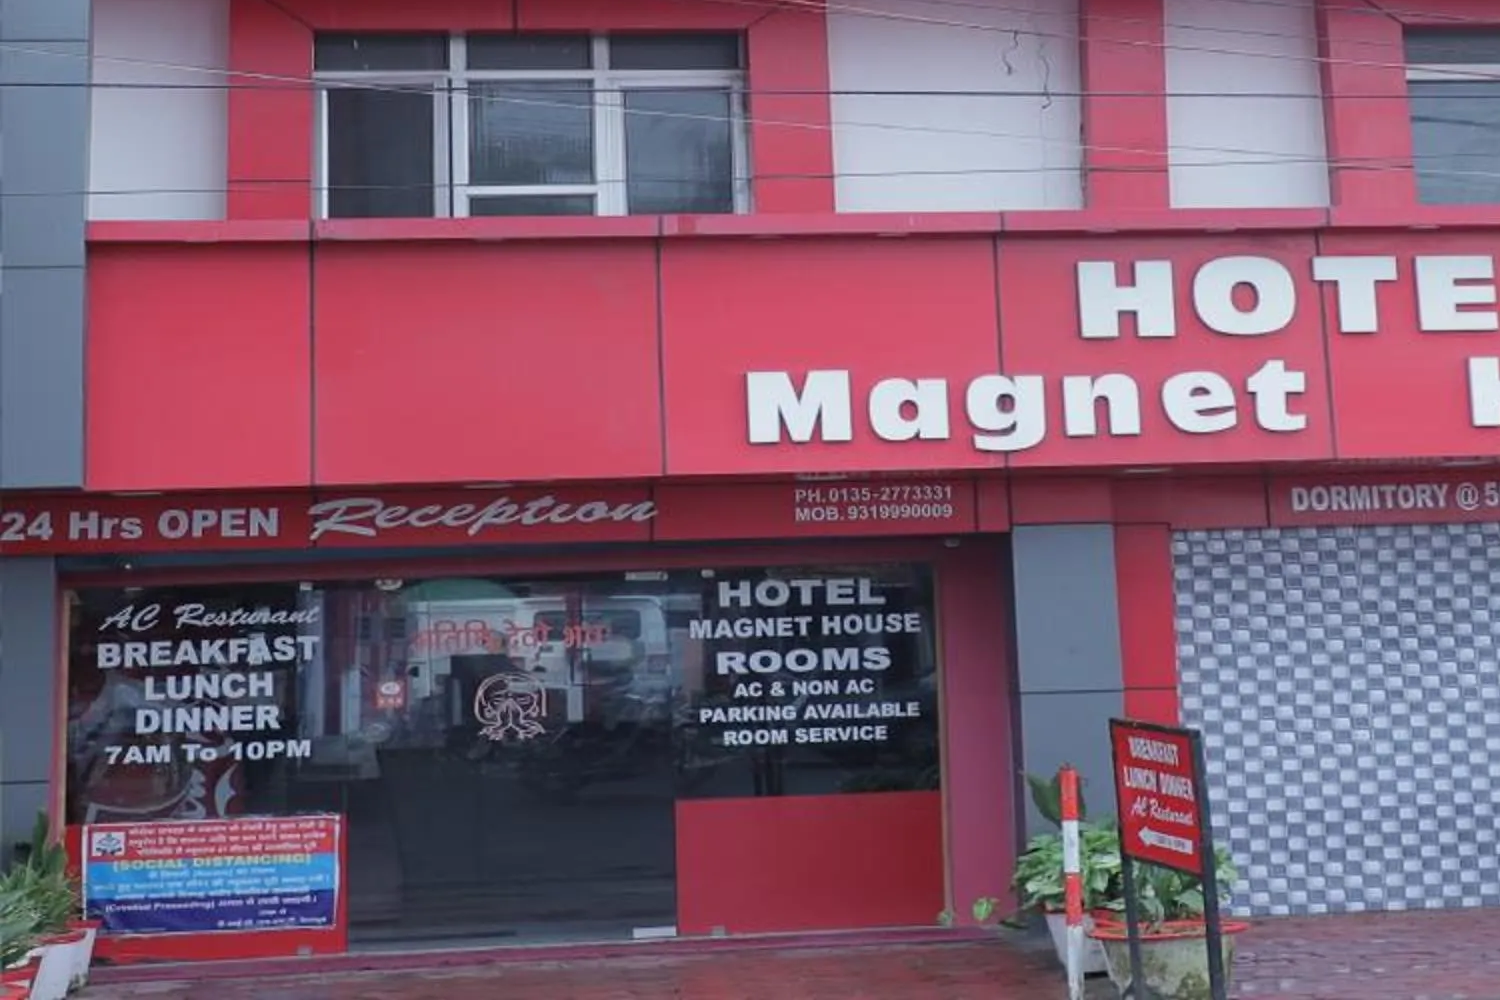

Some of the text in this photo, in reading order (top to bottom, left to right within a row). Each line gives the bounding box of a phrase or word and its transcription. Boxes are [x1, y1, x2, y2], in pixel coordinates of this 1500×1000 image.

[745, 358, 1307, 453] Magnet
[1291, 482, 1448, 513] DORMITORY
[0, 507, 279, 541] 24 Hrs OPEN
[308, 496, 659, 542] Reception
[718, 578, 887, 608] HOTEL
[99, 603, 162, 631] AC
[690, 613, 922, 640] MAGNET HOUSE
[97, 634, 320, 669] BREAKFAST
[716, 647, 892, 675] ROOMS
[145, 671, 274, 701] LUNCH
[734, 678, 875, 698] AC & NON AC
[135, 704, 282, 735] DINNER
[700, 702, 921, 723] PARKING AVAILABLE
[723, 725, 889, 746] ROOM SERVICE
[105, 739, 312, 765] 7AM To 10PM
